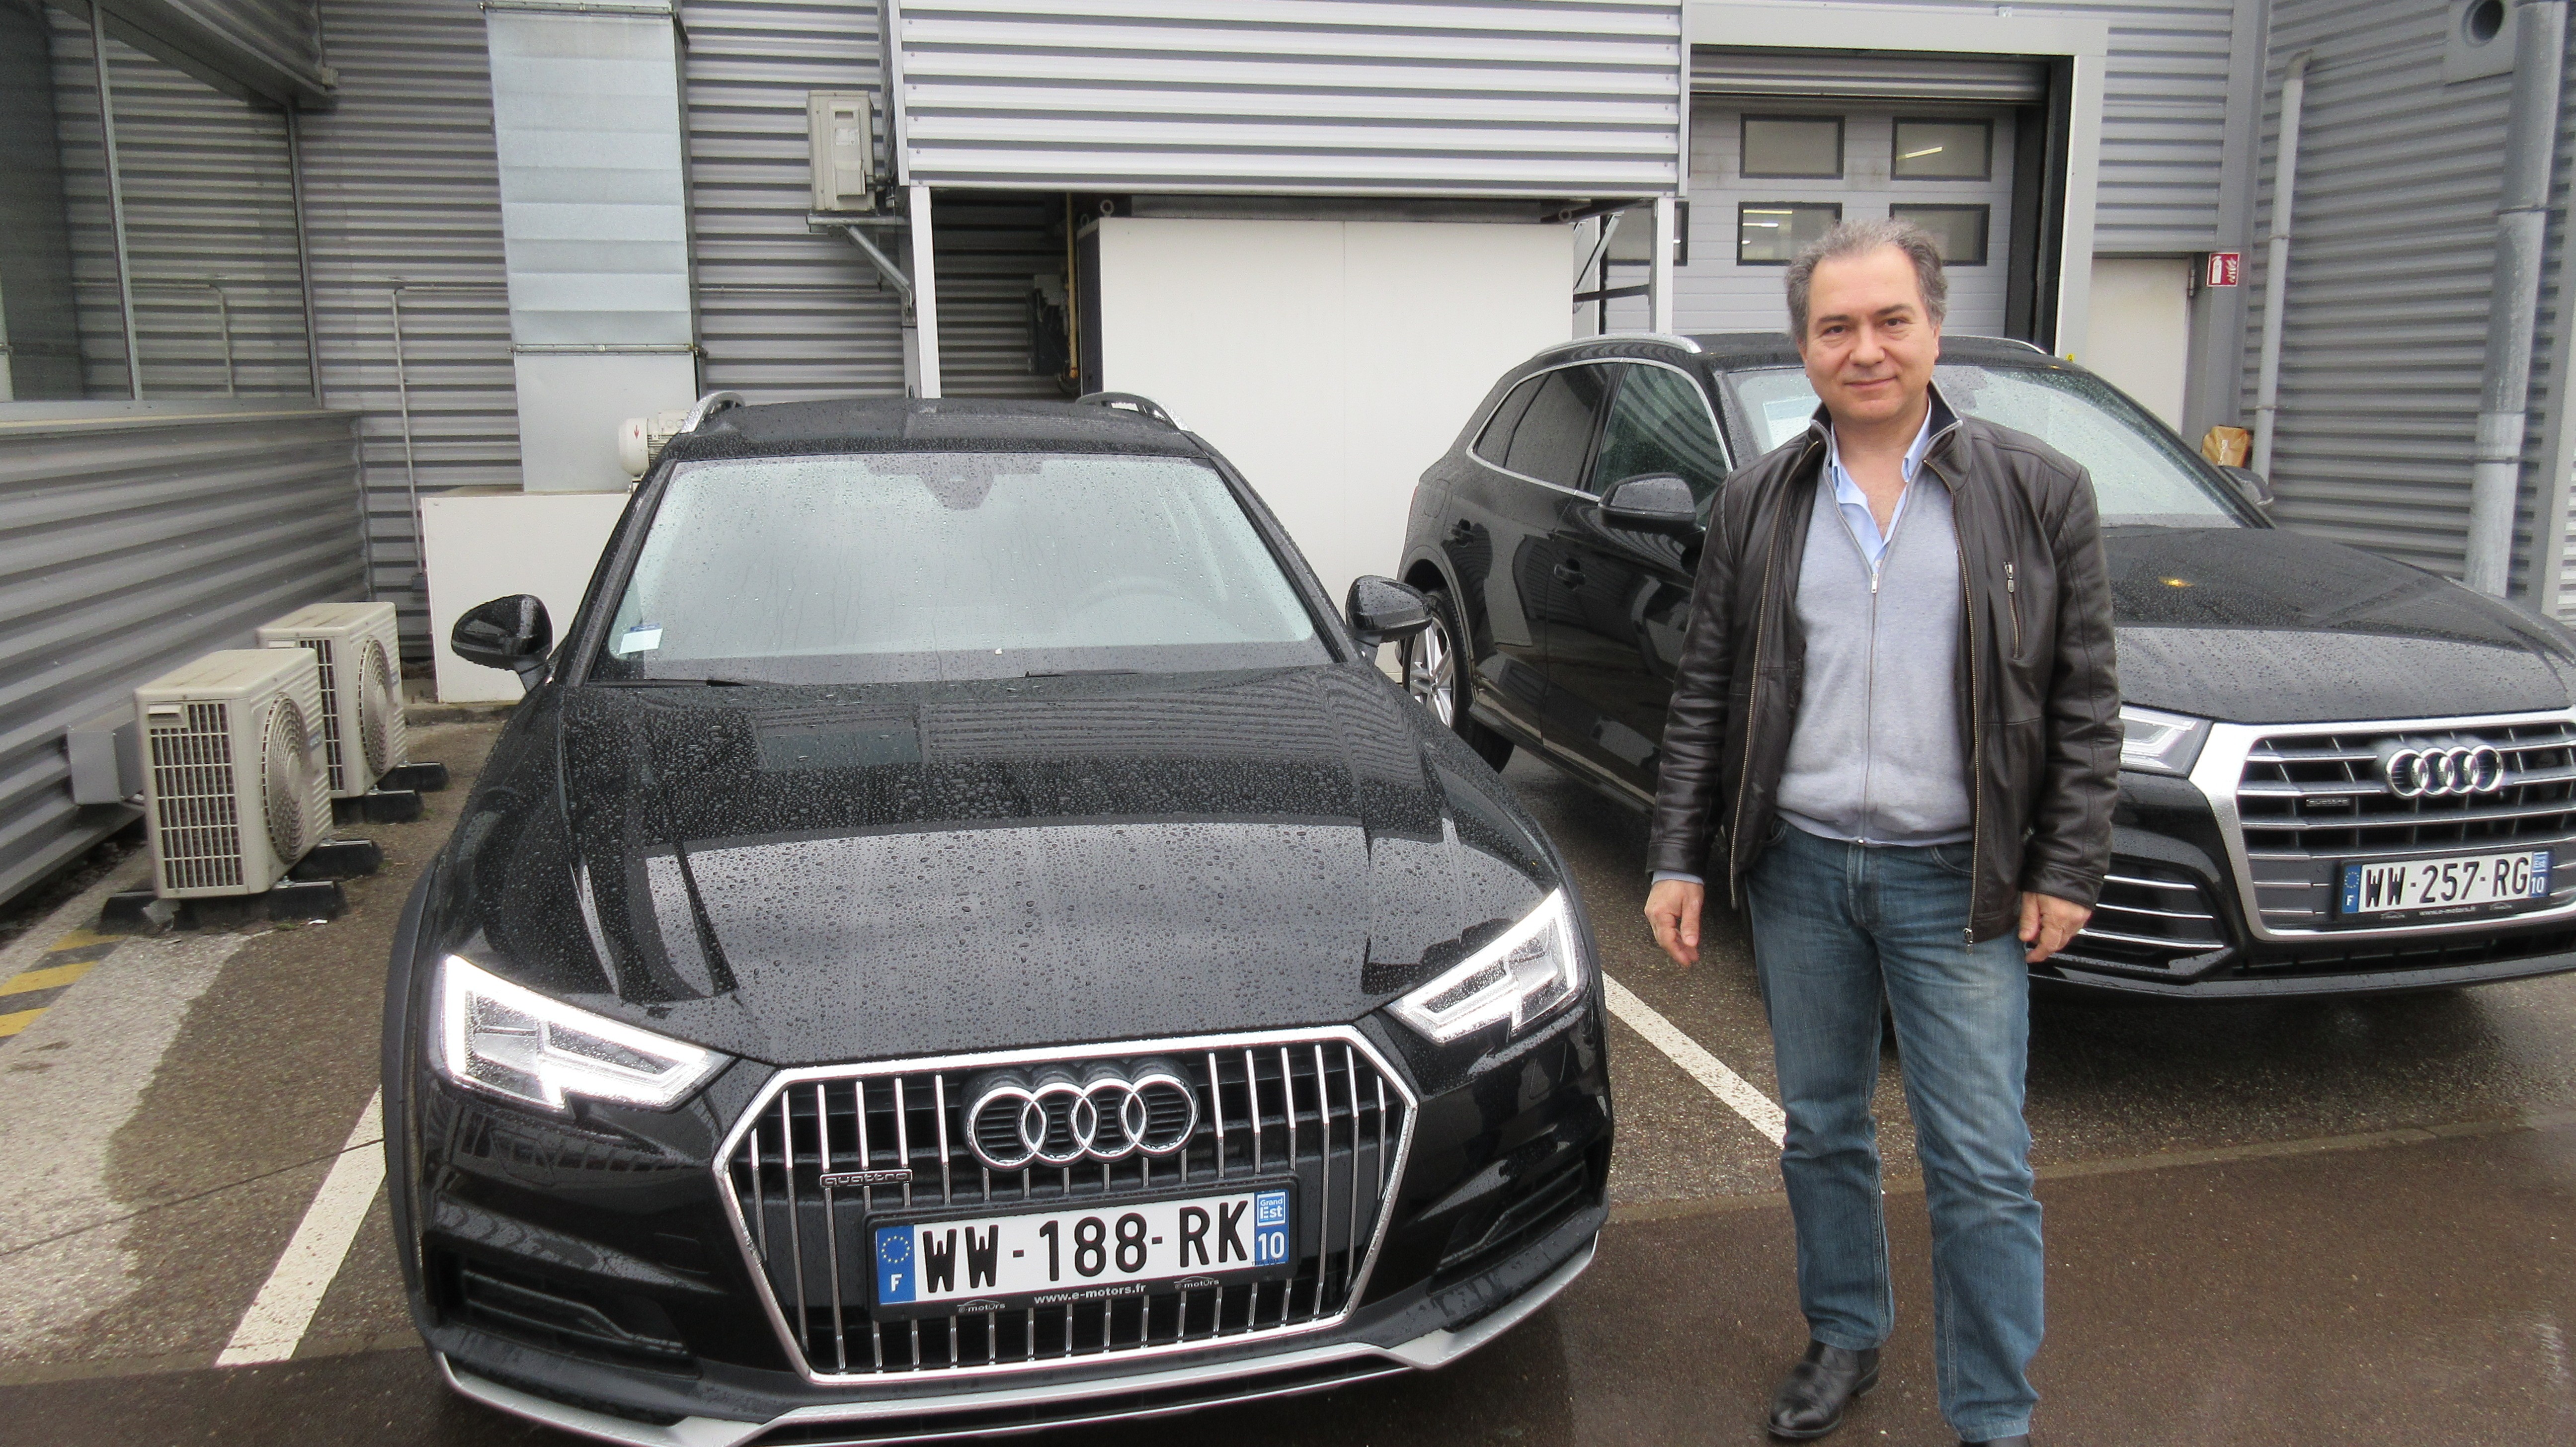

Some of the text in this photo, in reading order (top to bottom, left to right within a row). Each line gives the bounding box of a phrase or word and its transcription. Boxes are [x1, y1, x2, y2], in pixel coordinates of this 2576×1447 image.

[2366, 857, 2529, 908] WW-257-RG
[2532, 877, 2545, 893] 10
[2347, 895, 2354, 906] F
[825, 1173, 907, 1186] quattro
[1260, 1198, 1283, 1206] Grand
[1260, 1206, 1283, 1219] Est
[923, 1201, 1248, 1293] WW-188-RK
[1258, 1231, 1285, 1260] 10
[891, 1274, 902, 1291] F
[1034, 1283, 1146, 1304] www.e-motors.fr
